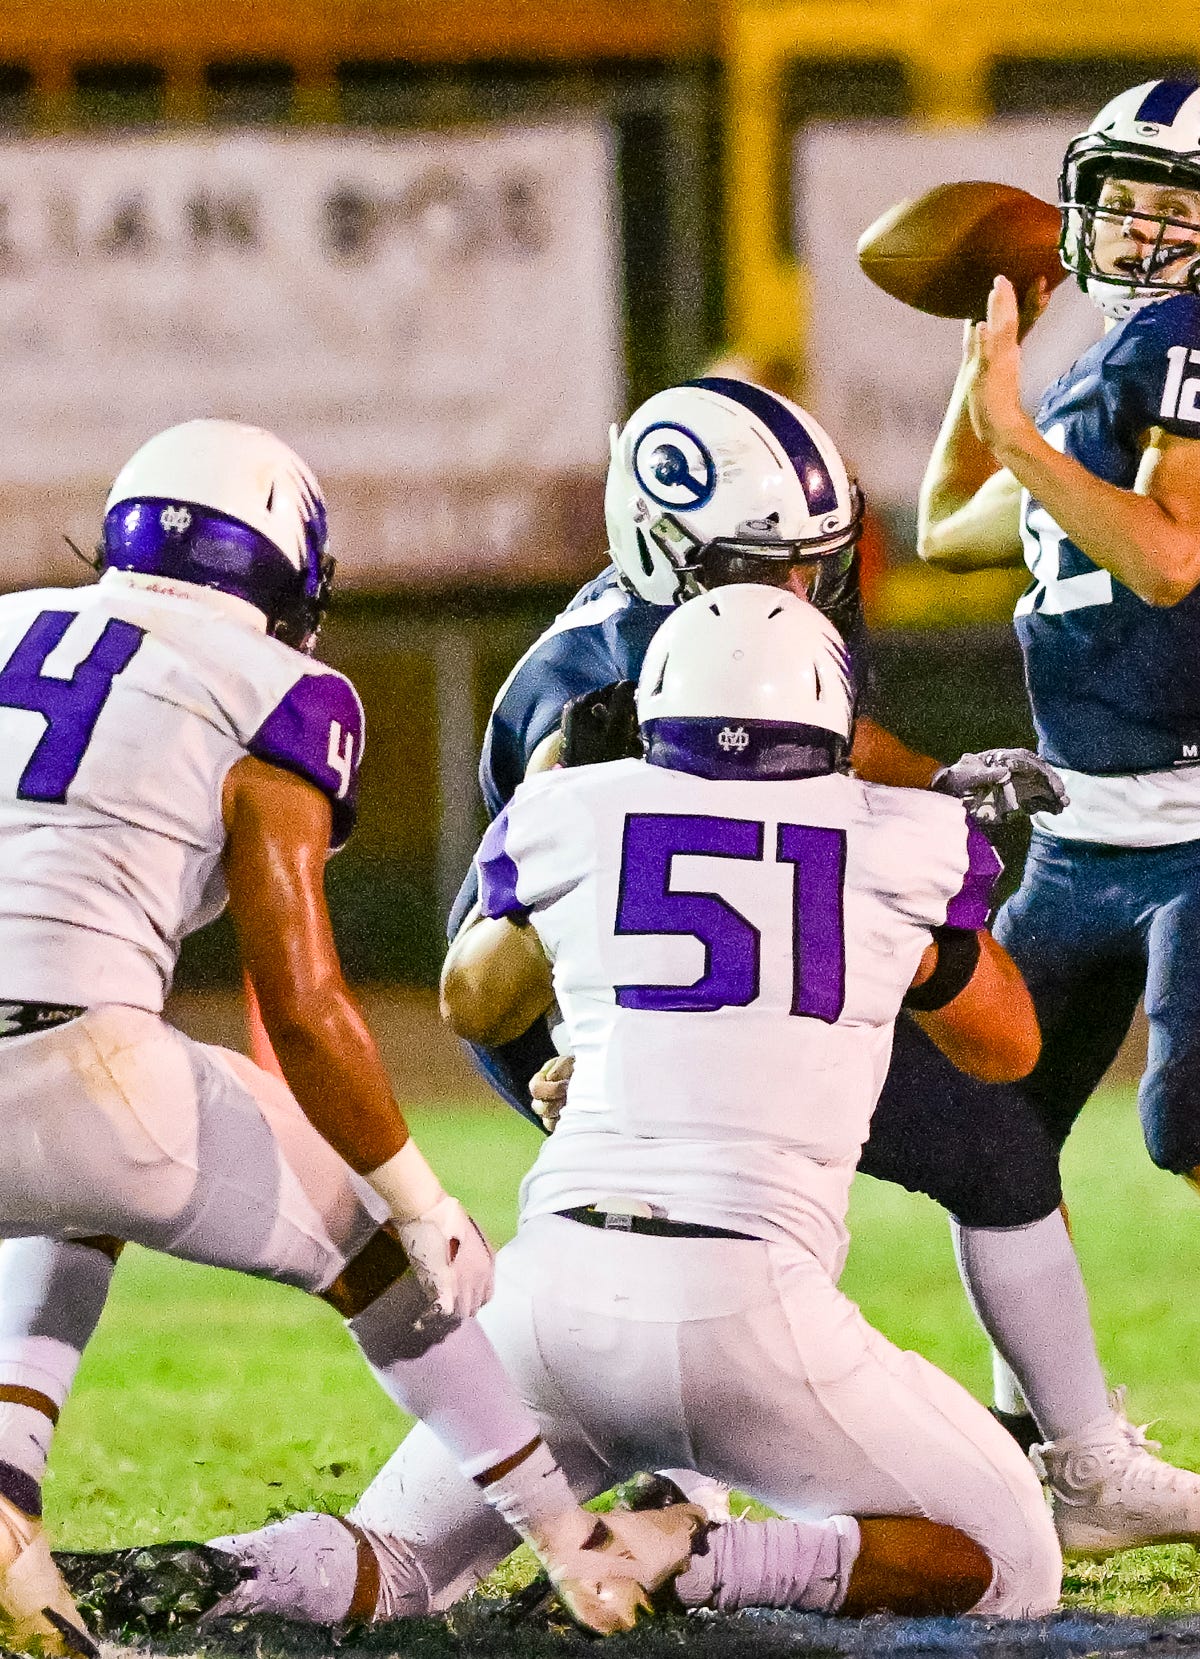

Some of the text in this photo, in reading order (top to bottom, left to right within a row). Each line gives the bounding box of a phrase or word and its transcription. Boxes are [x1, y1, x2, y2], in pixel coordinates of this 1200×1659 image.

[0, 610, 150, 805] 4
[327, 719, 354, 799] 4
[1182, 744, 1199, 758] M
[613, 812, 847, 1025] 51
